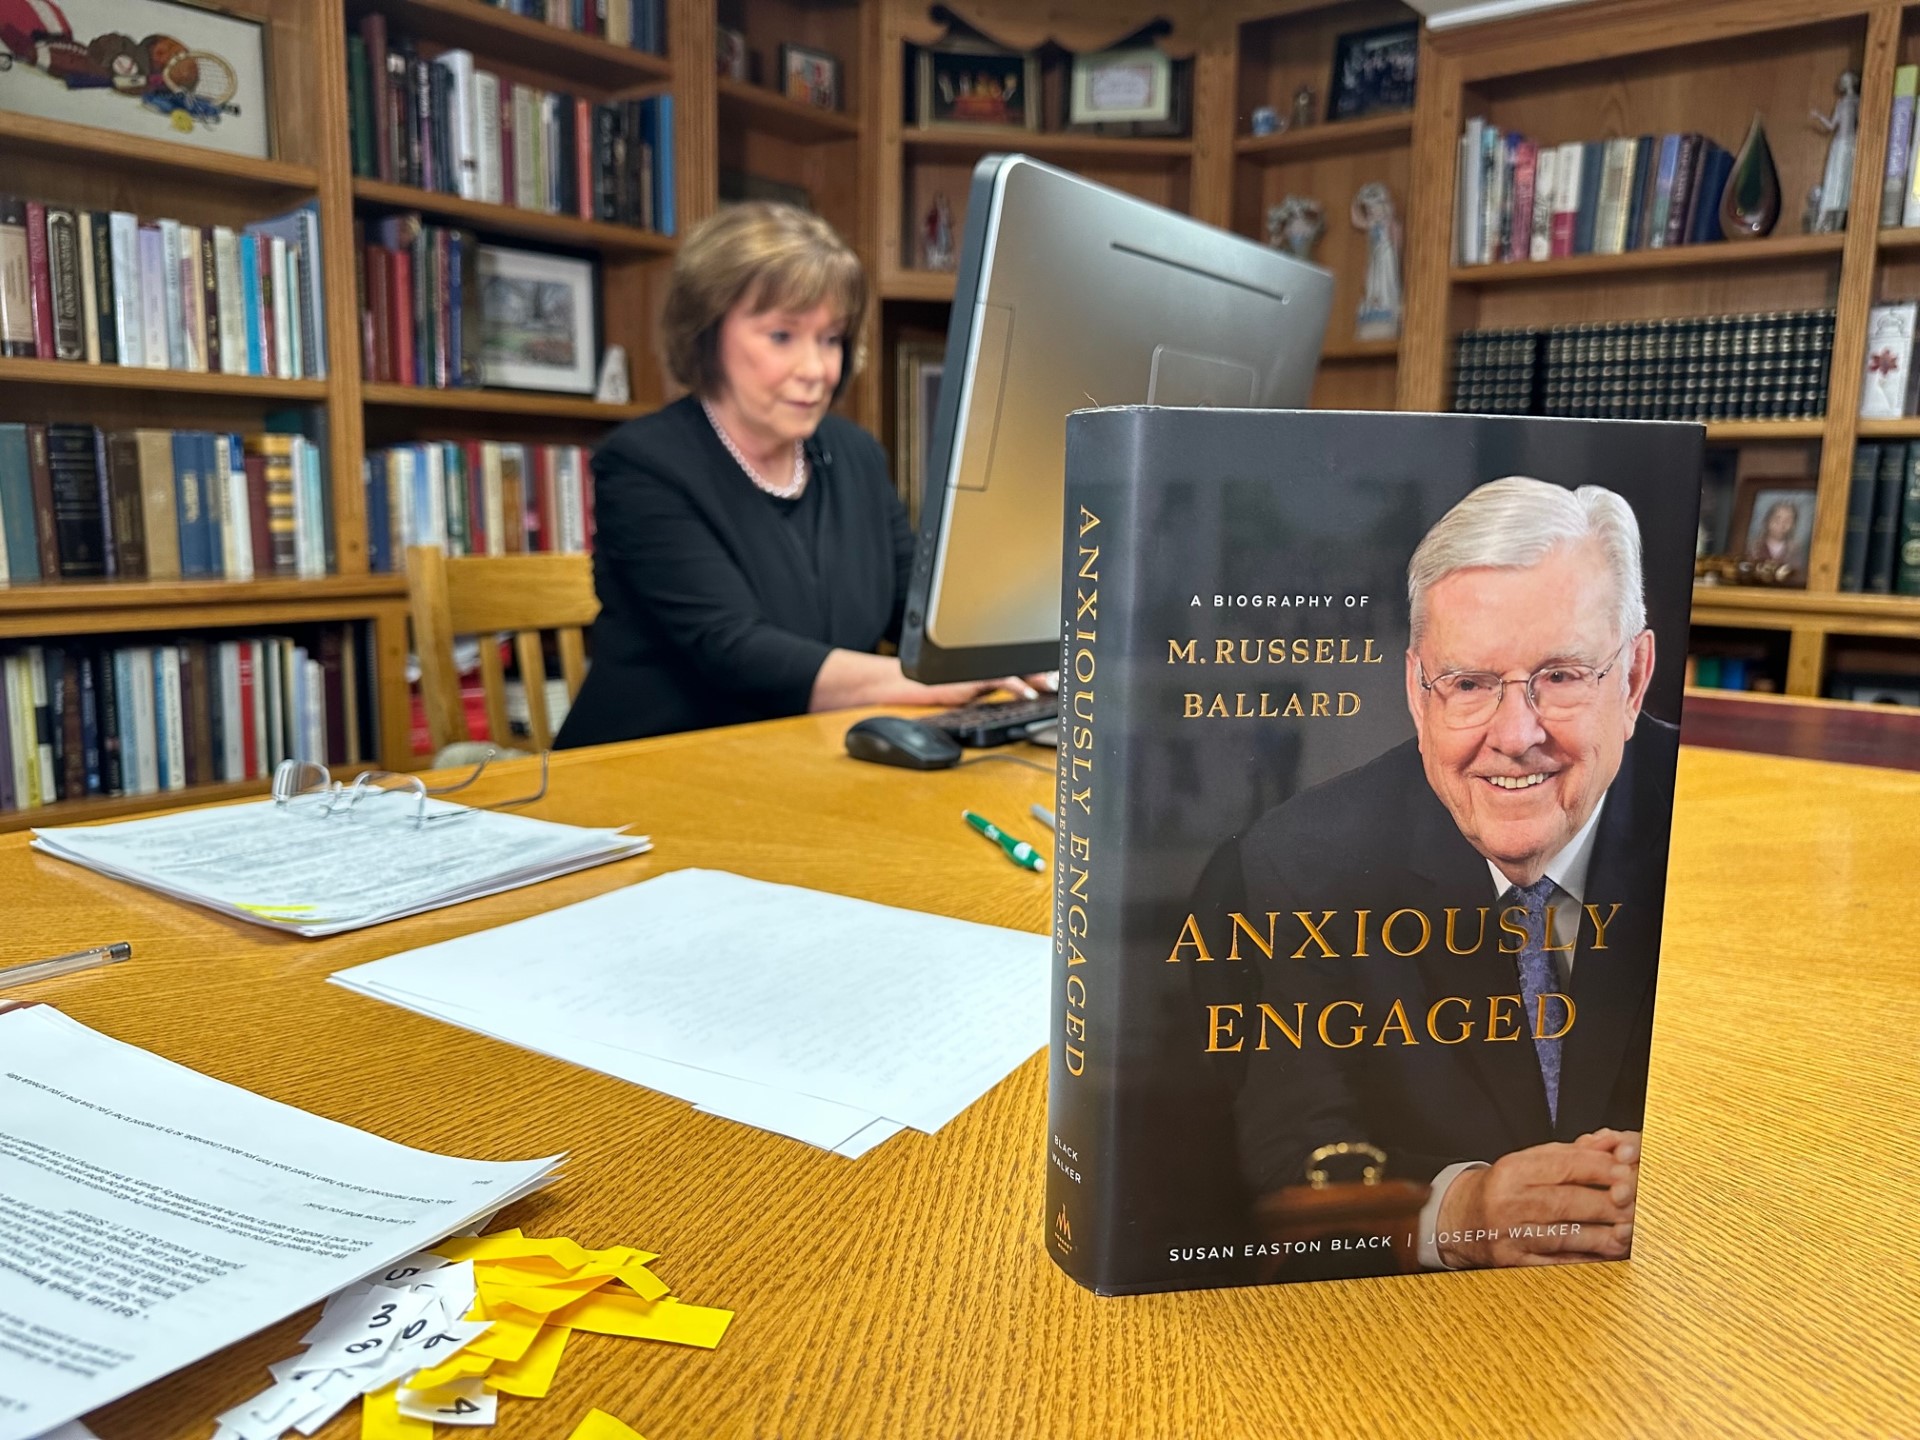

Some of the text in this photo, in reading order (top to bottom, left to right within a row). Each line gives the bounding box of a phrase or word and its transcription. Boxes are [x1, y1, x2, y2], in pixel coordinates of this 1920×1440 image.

[1190, 594, 1370, 608] A BIOGRAPHY OF
[1064, 620, 1070, 628] A
[1183, 692, 1362, 719] BALLARD
[1062, 716, 1068, 732] OF
[1065, 504, 1101, 1077] ANXIOUSLY ENGAGED
[1056, 861, 1066, 955] BALLARD
[1166, 903, 1623, 1053] ANXIOUSLY ENGAGED
[1054, 1134, 1078, 1162] BLACK
[1051, 1151, 1082, 1184] WALKER
[1169, 1223, 1582, 1262] SUSAN EASTON BLACK JOSEPH WALKER
